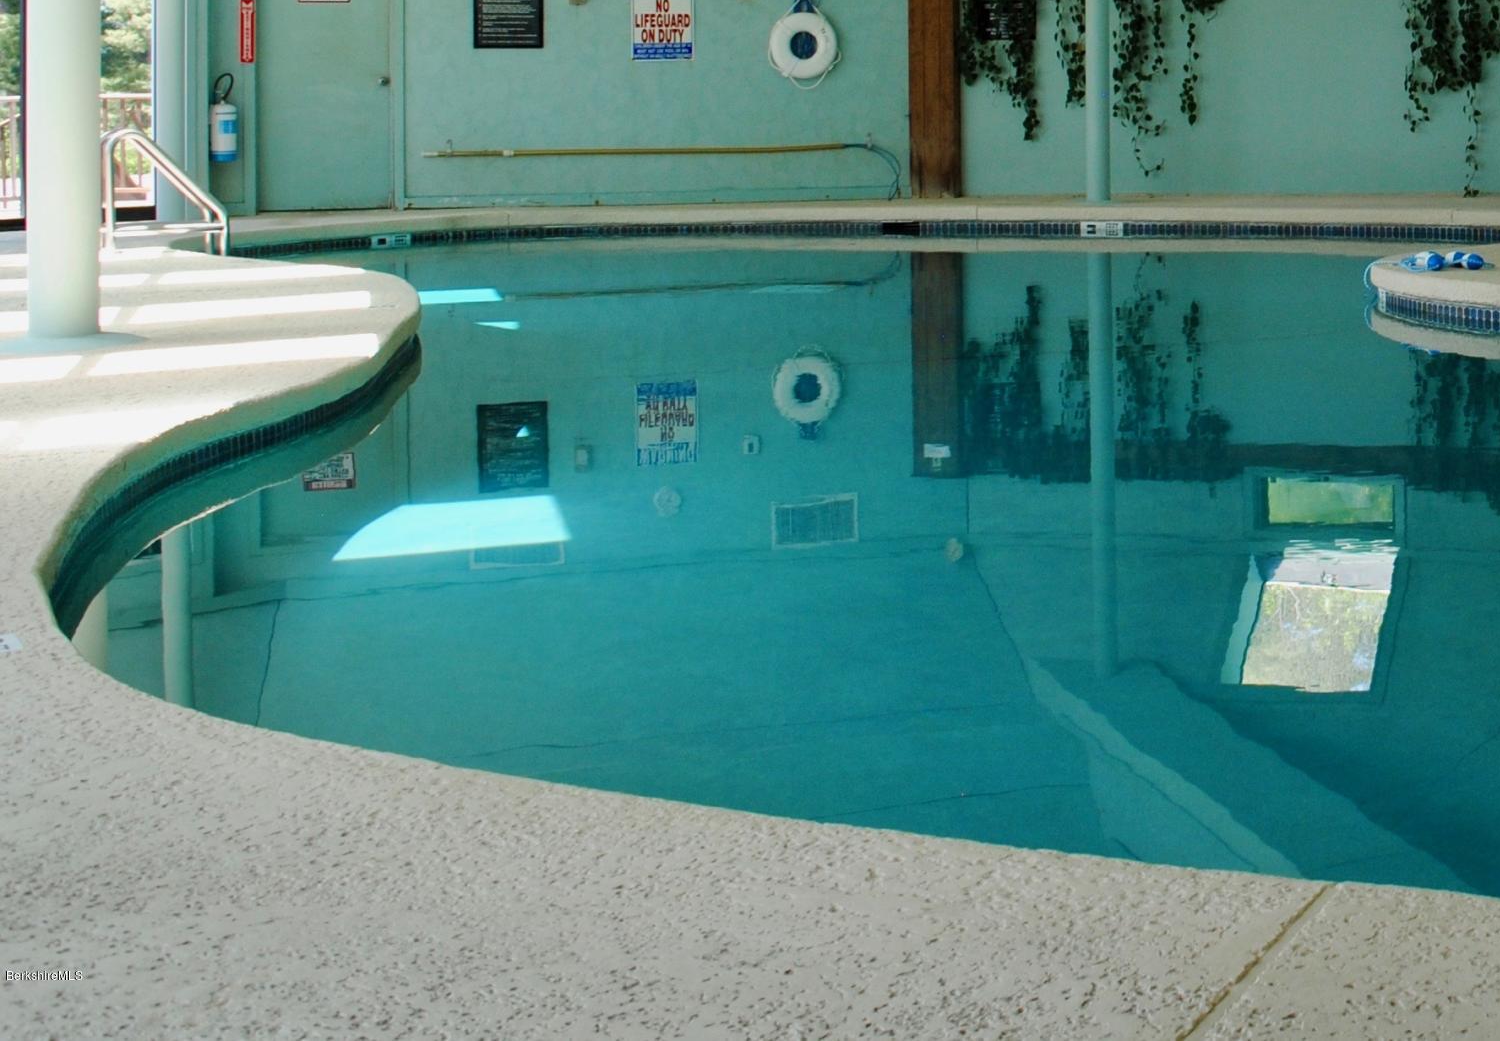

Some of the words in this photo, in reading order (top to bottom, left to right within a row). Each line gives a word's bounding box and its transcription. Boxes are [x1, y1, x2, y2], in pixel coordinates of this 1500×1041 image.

[635, 13, 691, 28] LIFEGUARD
[641, 29, 655, 43] ON
[658, 28, 684, 43] DUTY
